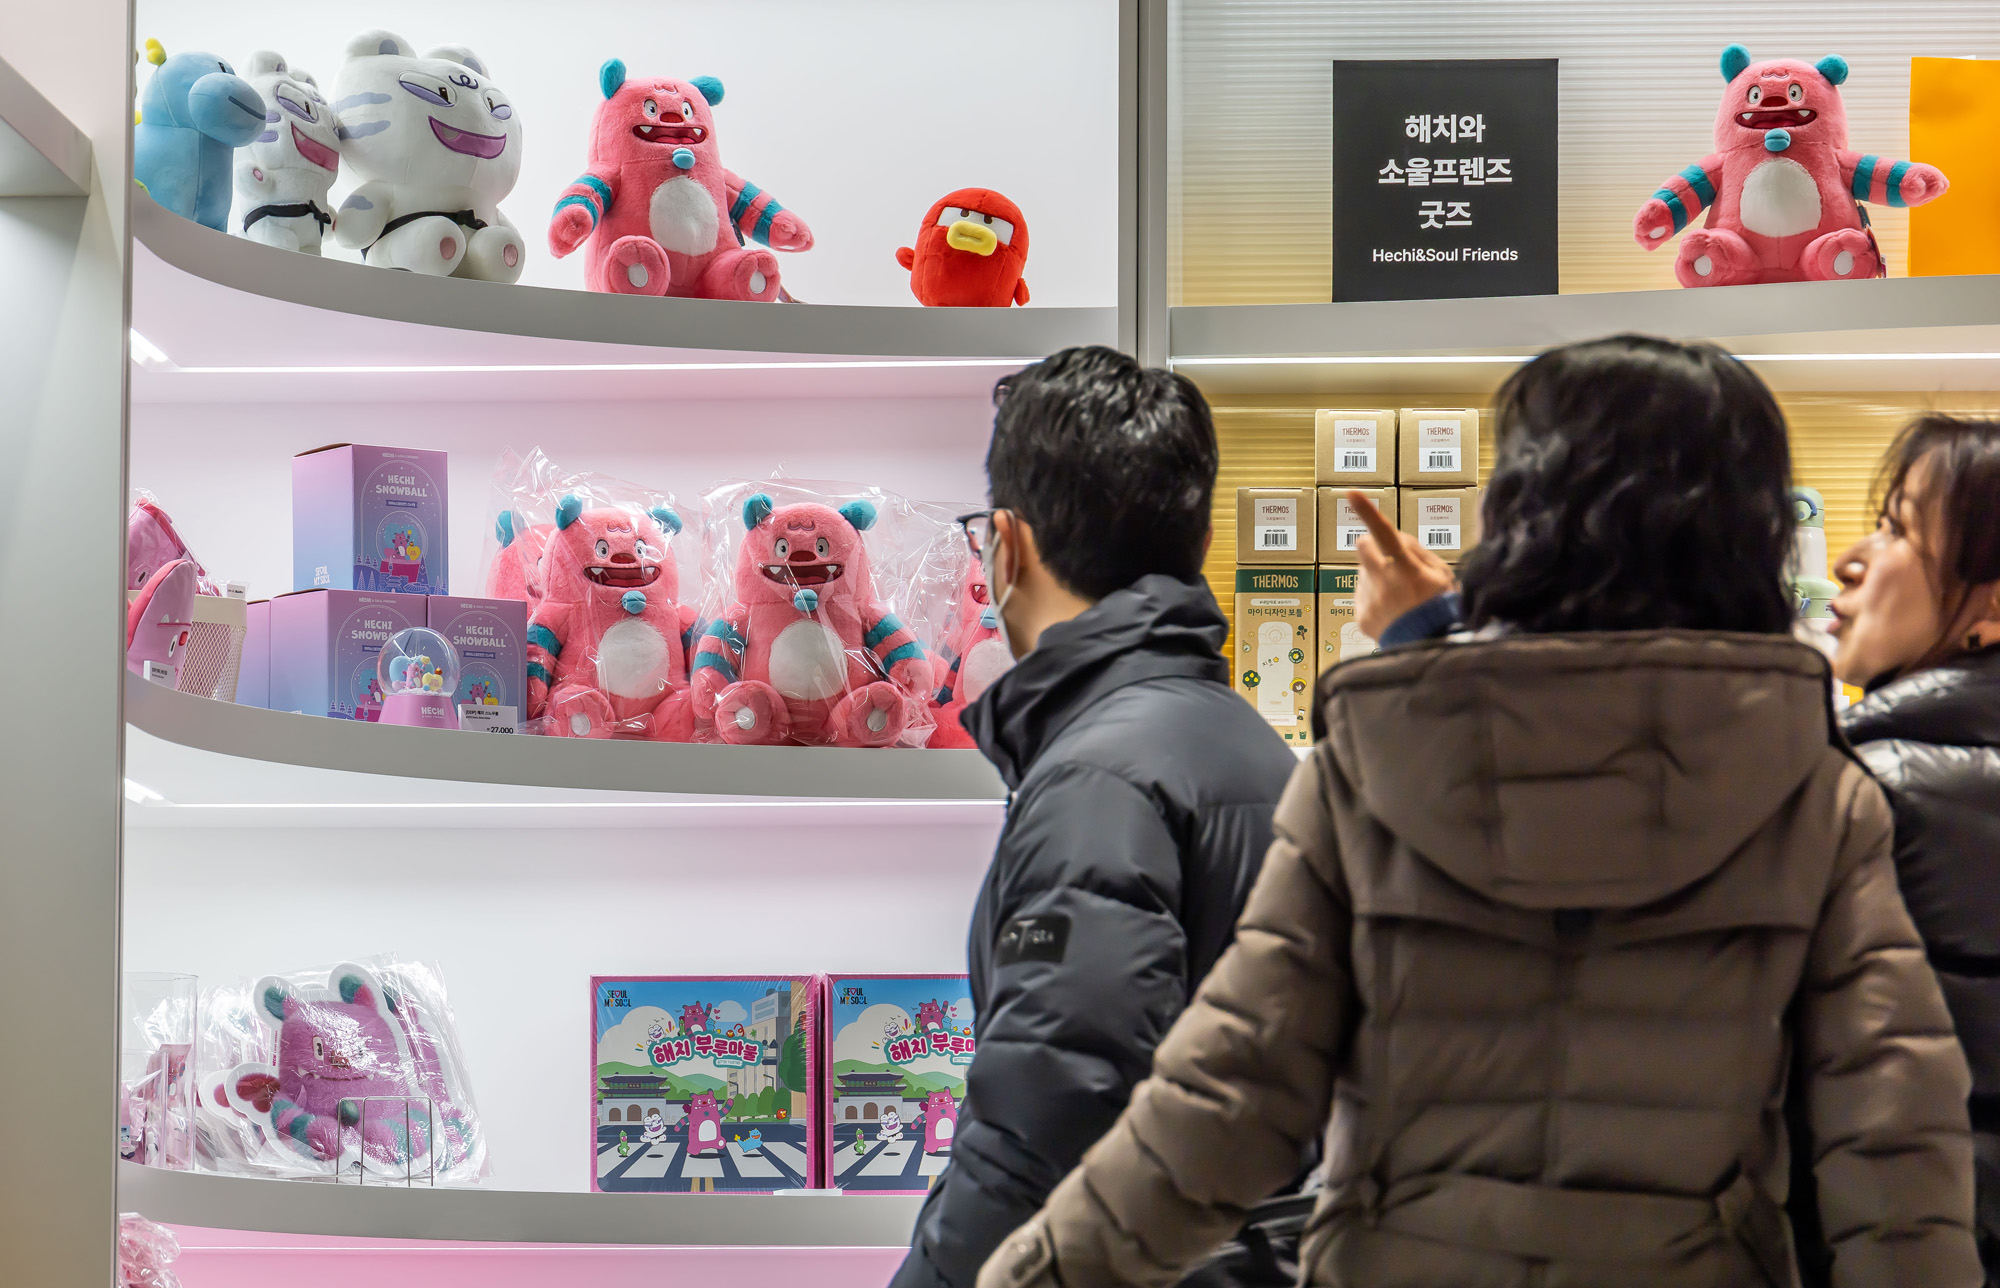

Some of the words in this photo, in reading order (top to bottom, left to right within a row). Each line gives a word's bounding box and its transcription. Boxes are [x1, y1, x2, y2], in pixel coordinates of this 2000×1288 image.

[1405, 114, 1486, 143] 해치와
[1378, 157, 1513, 186] 소울프렌즈
[1418, 201, 1473, 229] 굿즈
[1372, 249, 1459, 262] Hechi&Soul
[1462, 248, 1519, 261] Friends
[1342, 427, 1370, 436] THERMOS
[1427, 427, 1454, 436] THERMOS
[387, 474, 416, 485] HECHI
[375, 484, 428, 497] SNOWBALL
[1262, 505, 1290, 514] THERMOS
[1426, 504, 1454, 513] THERMOS
[1252, 574, 1299, 588] THERMOS
[1335, 574, 1359, 589] THER
[1247, 608, 1263, 616] 마이
[1264, 608, 1287, 618] 디자인
[1330, 608, 1345, 617] 마이
[364, 620, 393, 630] HECHI
[465, 625, 494, 636] HECHI
[351, 630, 395, 641] SNOWBA
[453, 635, 506, 648] SNOWBALL
[421, 706, 445, 716] HECHI
[653, 1040, 691, 1063] 해치
[695, 1035, 758, 1062] 부루마불
[889, 1037, 927, 1061] 해치
[932, 1032, 975, 1054] 부루
